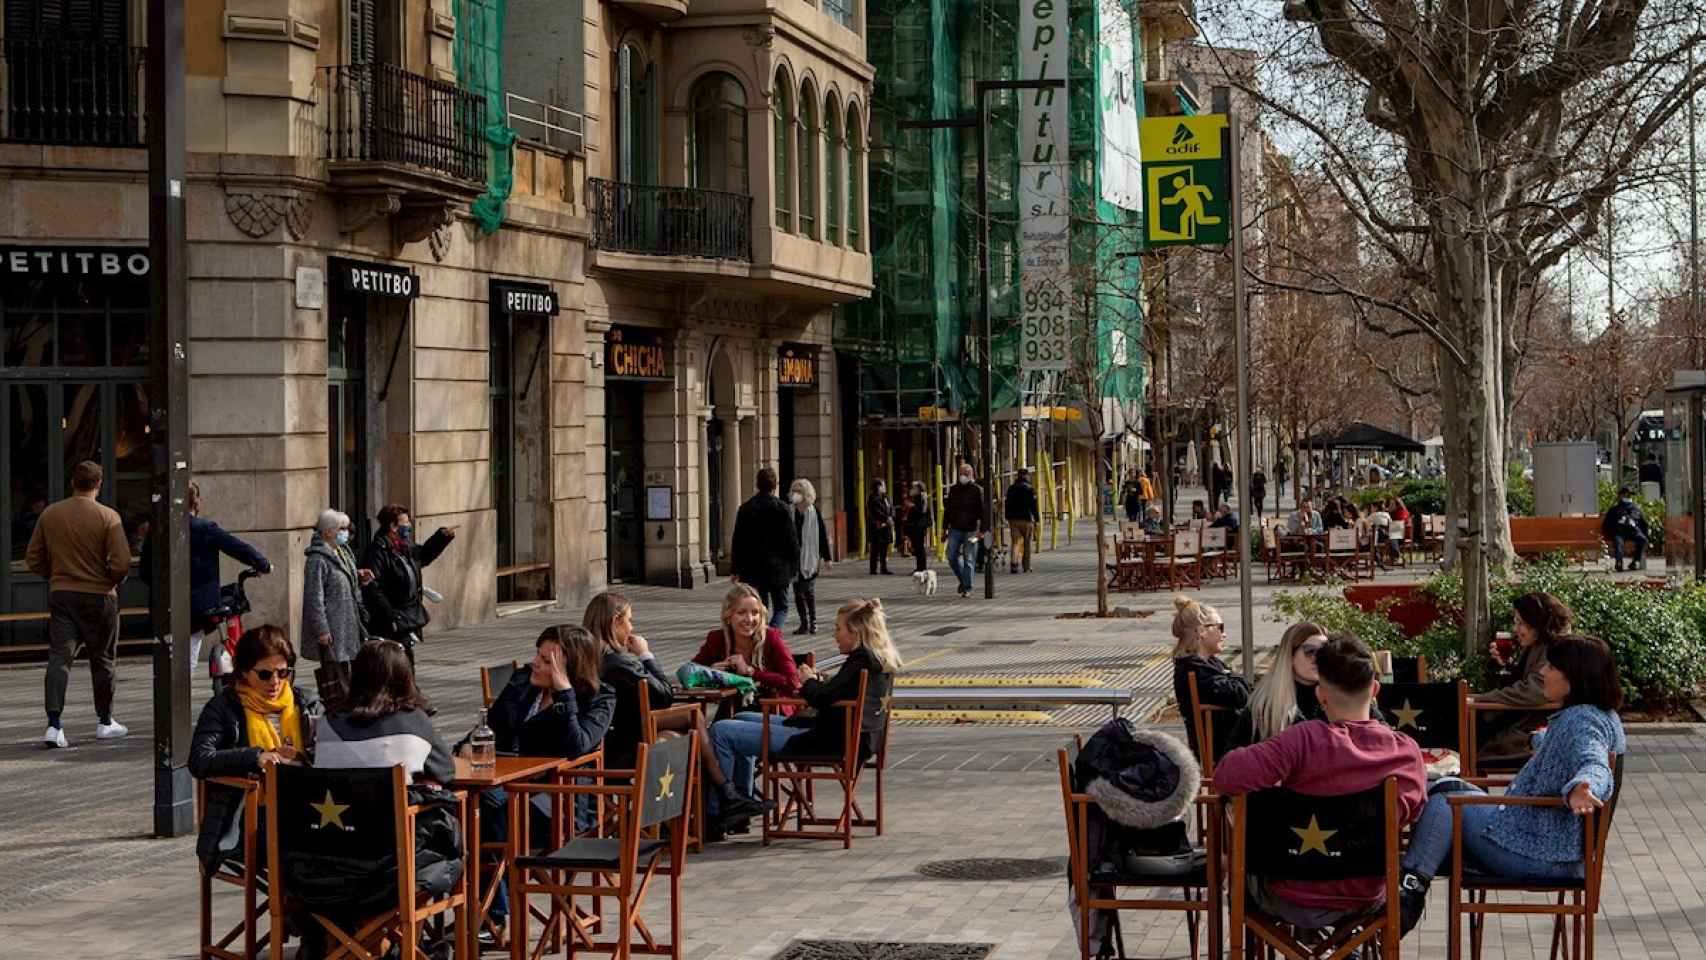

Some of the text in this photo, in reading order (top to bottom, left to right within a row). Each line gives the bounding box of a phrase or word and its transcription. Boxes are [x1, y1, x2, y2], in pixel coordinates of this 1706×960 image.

[1165, 143, 1201, 154] adif
[0, 251, 150, 275] ETITBO
[351, 268, 412, 296] PETITBO
[507, 291, 552, 313] PETITBO
[1025, 289, 1065, 312] 934
[1025, 315, 1065, 337] 508
[1025, 340, 1065, 361] 933
